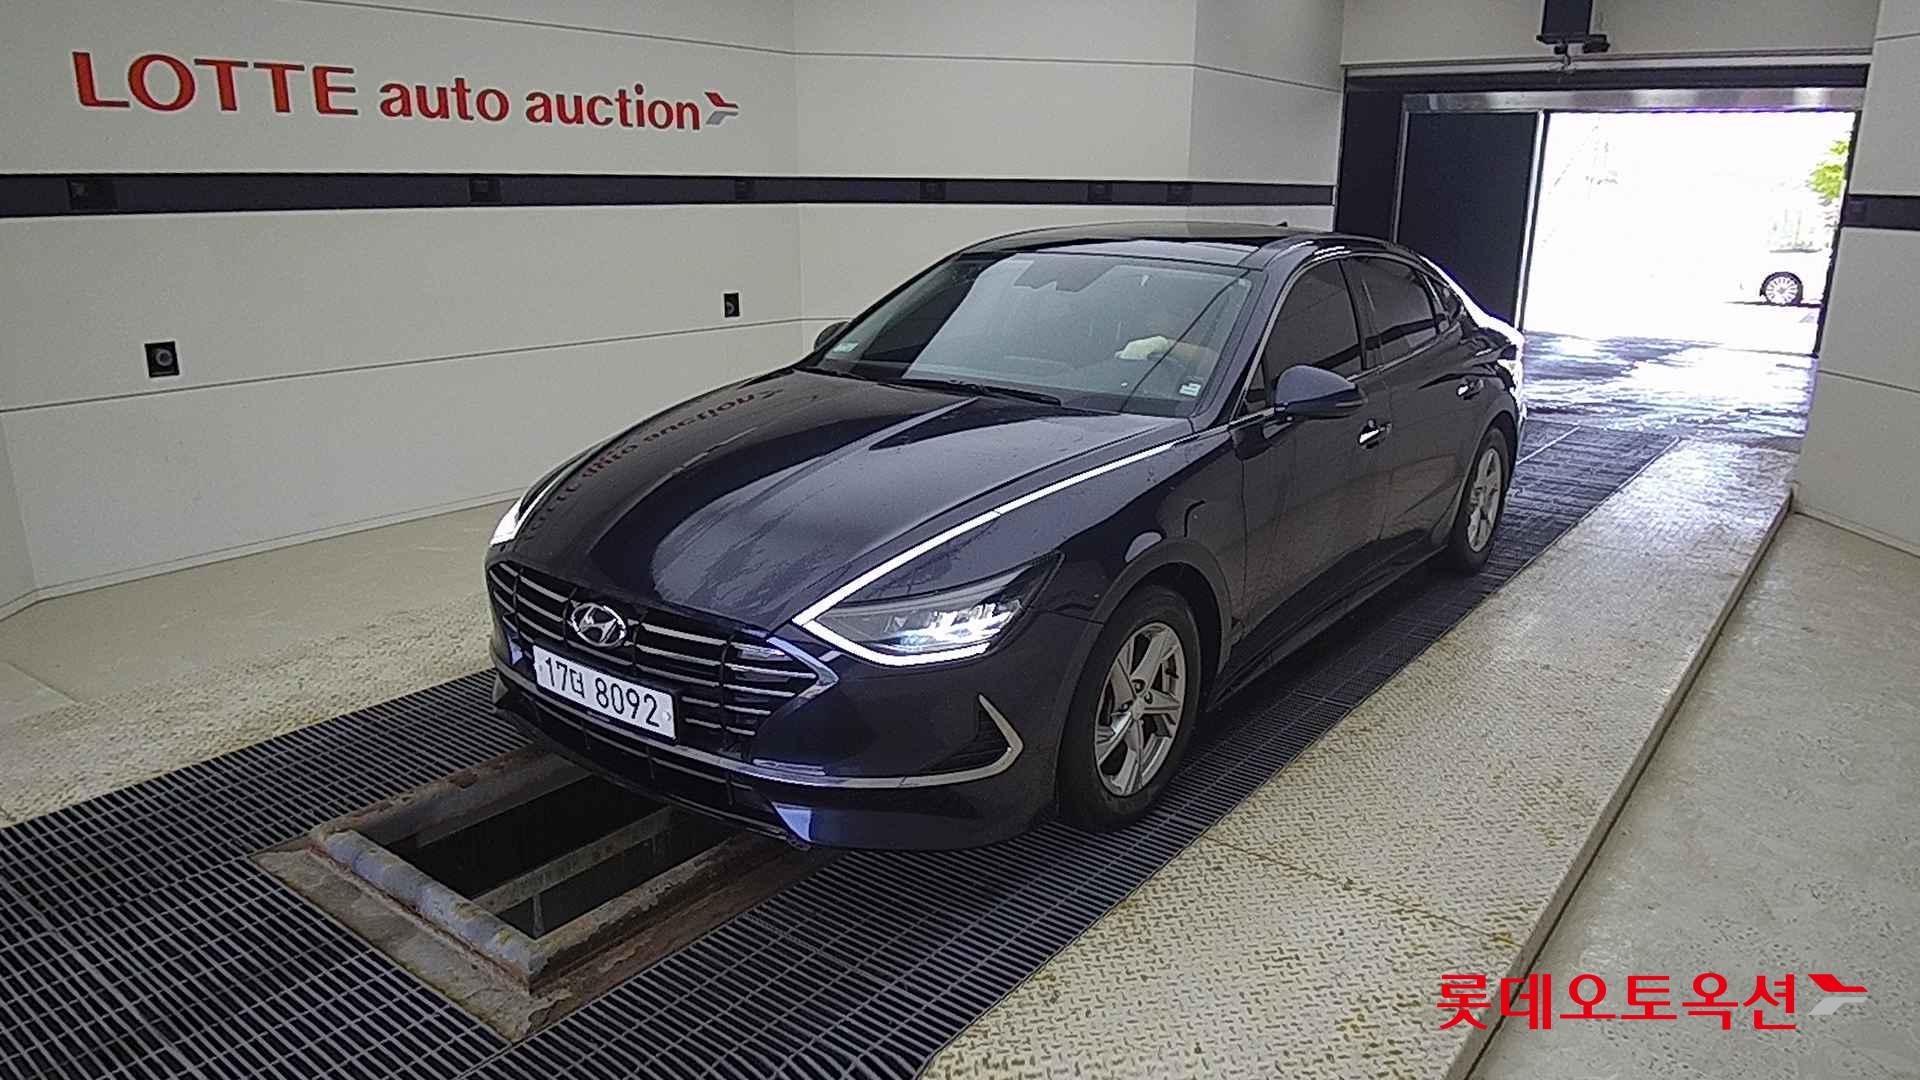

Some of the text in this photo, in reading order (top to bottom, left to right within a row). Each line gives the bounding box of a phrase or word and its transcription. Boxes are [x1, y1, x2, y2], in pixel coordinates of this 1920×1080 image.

[73, 51, 701, 130] LOTTE auto auction
[595, 677, 660, 727] 8092
